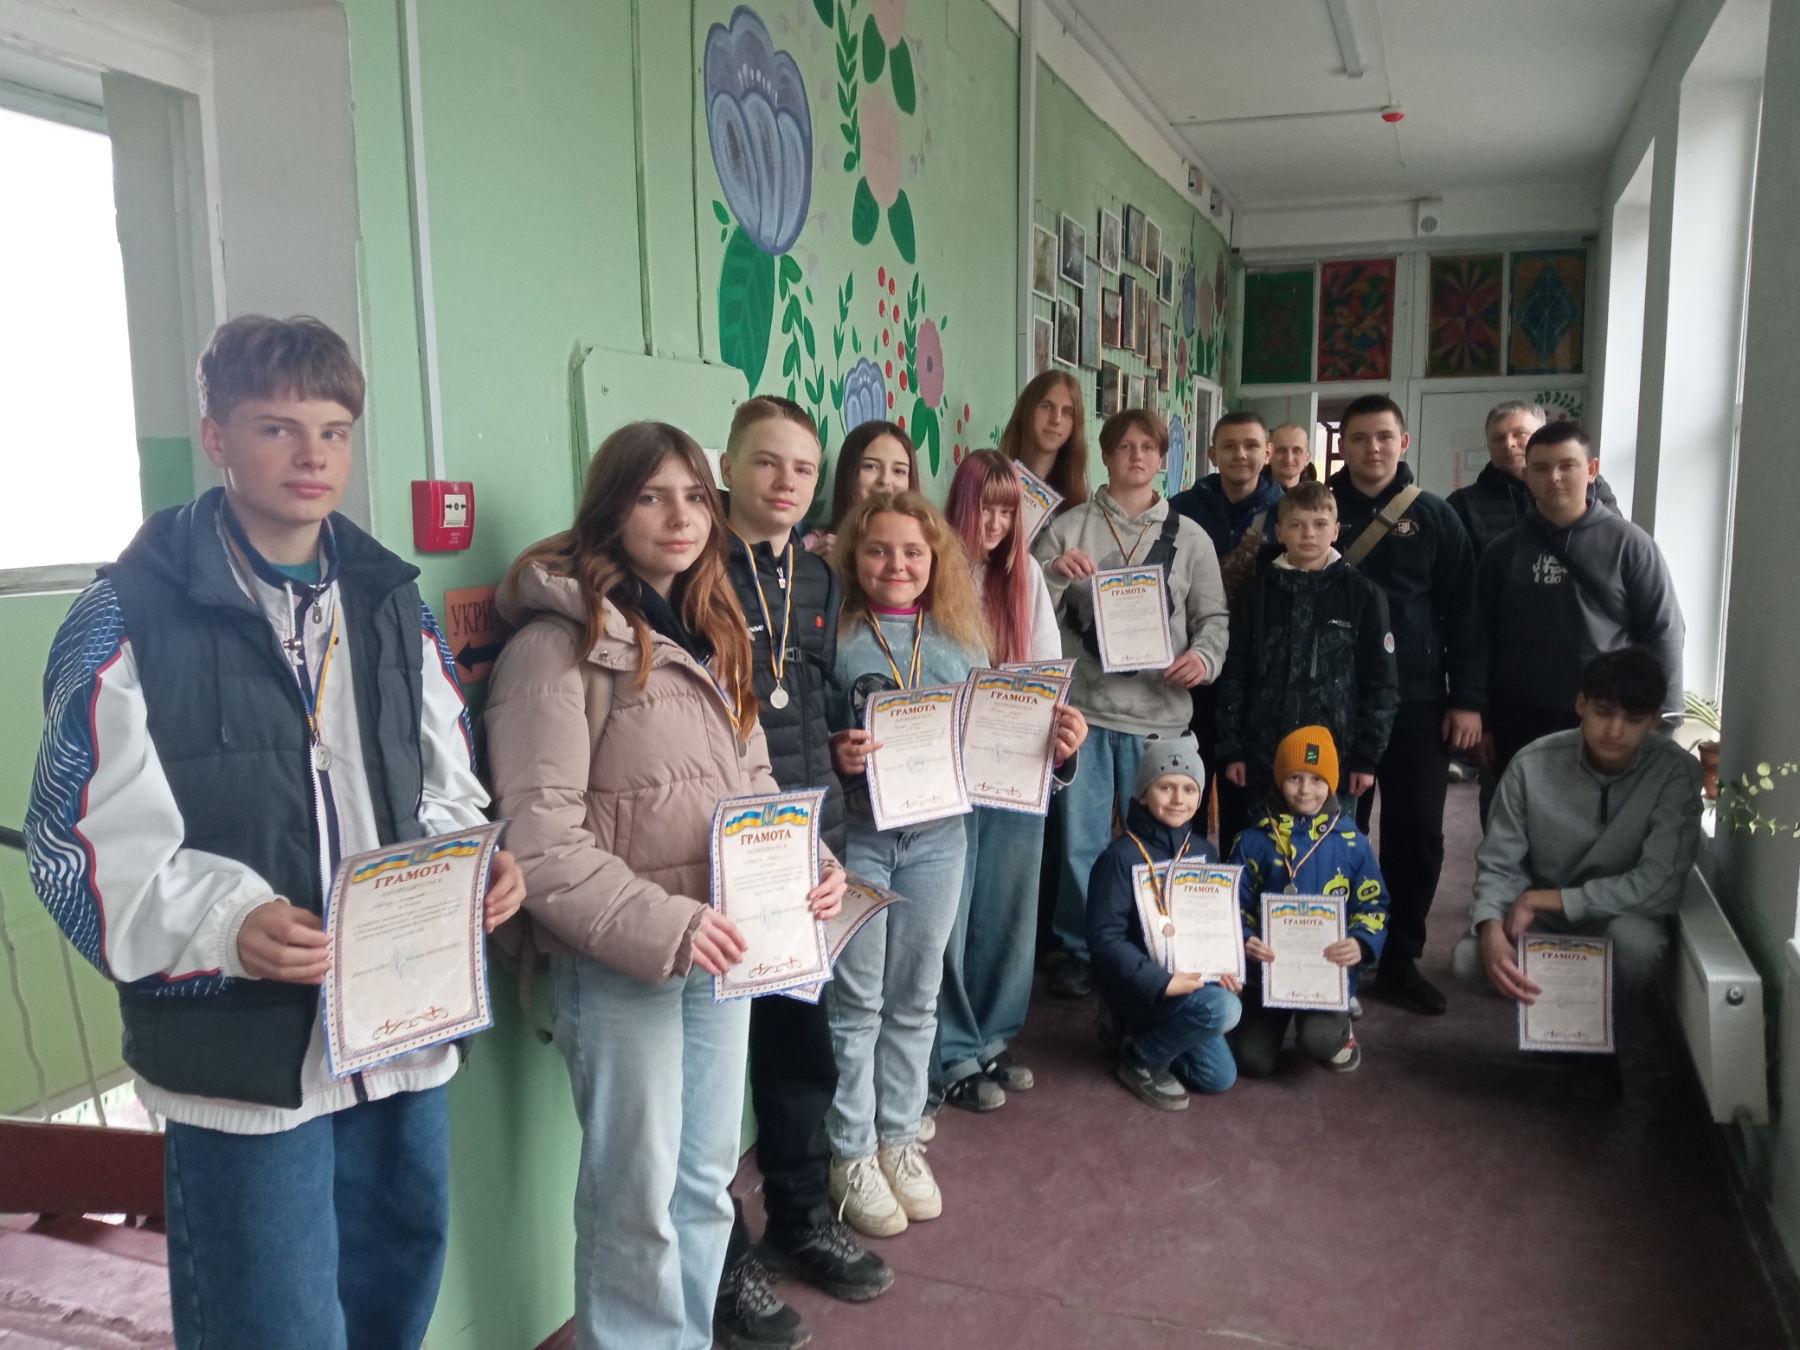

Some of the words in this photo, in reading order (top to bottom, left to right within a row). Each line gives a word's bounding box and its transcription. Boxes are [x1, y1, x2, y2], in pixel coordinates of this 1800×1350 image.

[1111, 587, 1146, 597] ГРАМОТА
[451, 601, 495, 637] УКРИ
[990, 691, 1039, 705] ГРАМОТА
[890, 704, 936, 718] ГРАМОТА
[740, 829, 791, 846] ГРАМОТА
[373, 862, 452, 890] ГРАМОТА
[1184, 885, 1220, 894] ГРАМОТА
[1283, 918, 1324, 927] ГРАМОТА
[1542, 952, 1588, 961] ГРАМОТА
